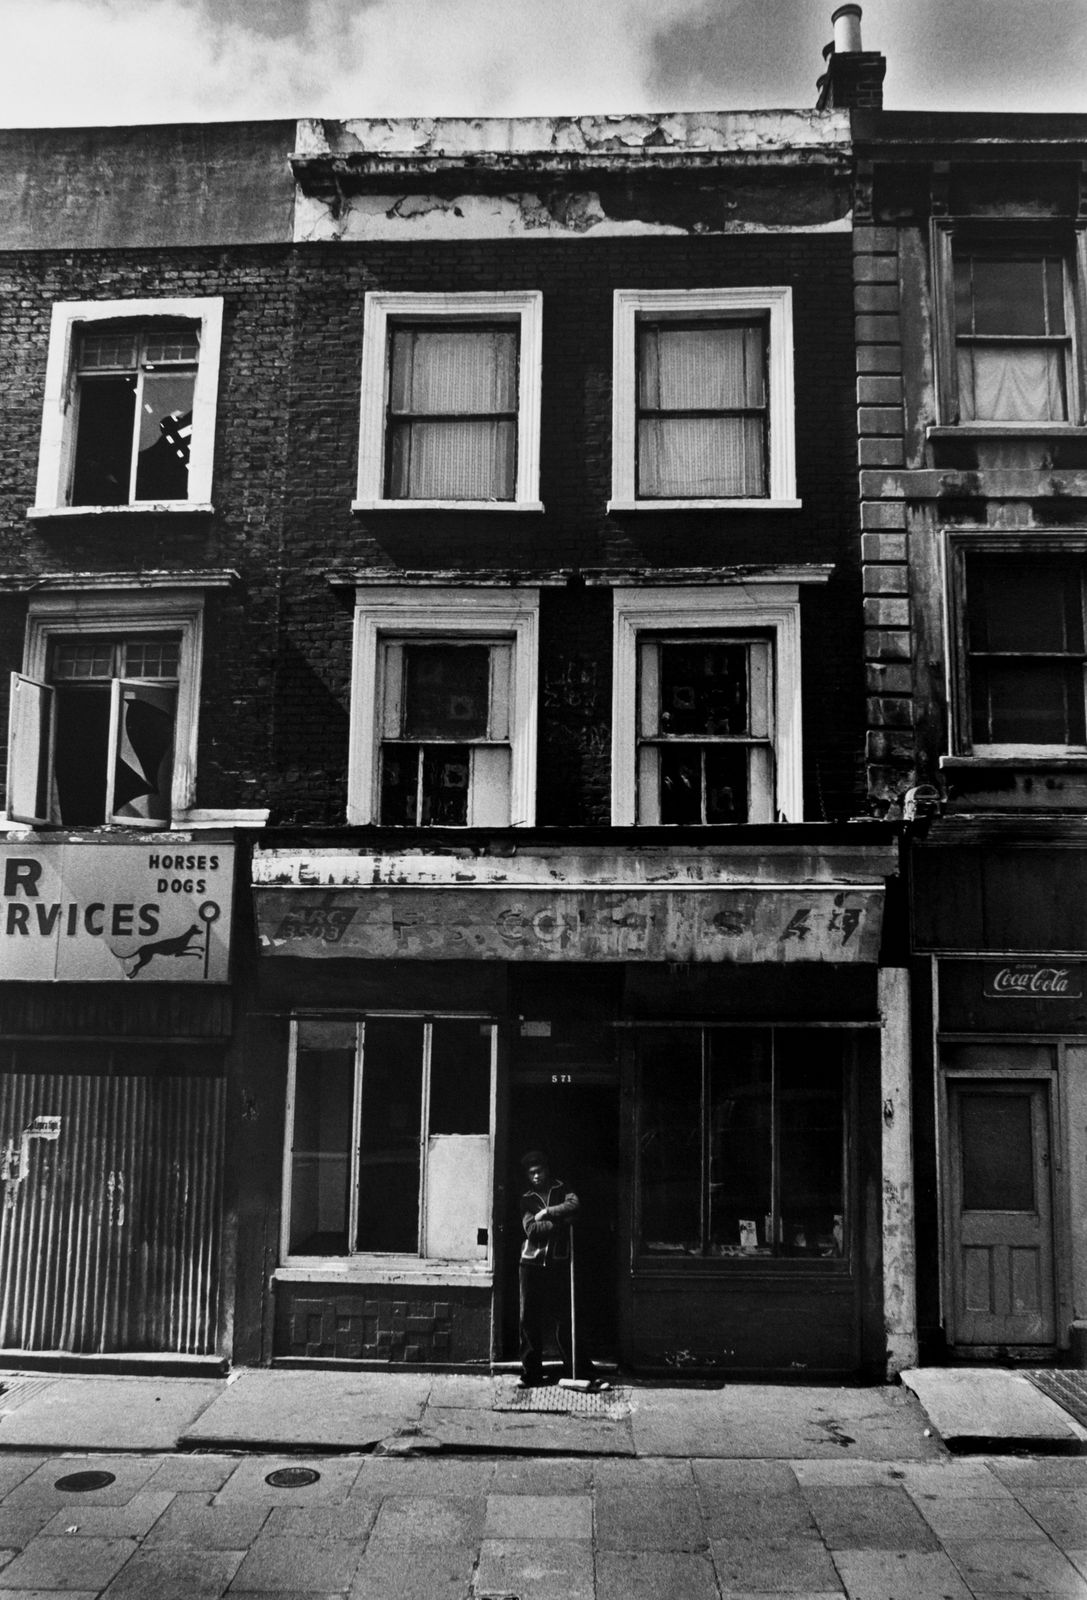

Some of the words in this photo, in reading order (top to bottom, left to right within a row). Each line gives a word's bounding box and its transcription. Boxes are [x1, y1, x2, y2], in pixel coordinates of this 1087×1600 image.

[149, 854, 219, 870] HORSES
[4, 858, 42, 897] R
[157, 878, 206, 893] DOGS
[5, 902, 160, 936] RVICES
[993, 968, 1071, 992] Coca-Cola
